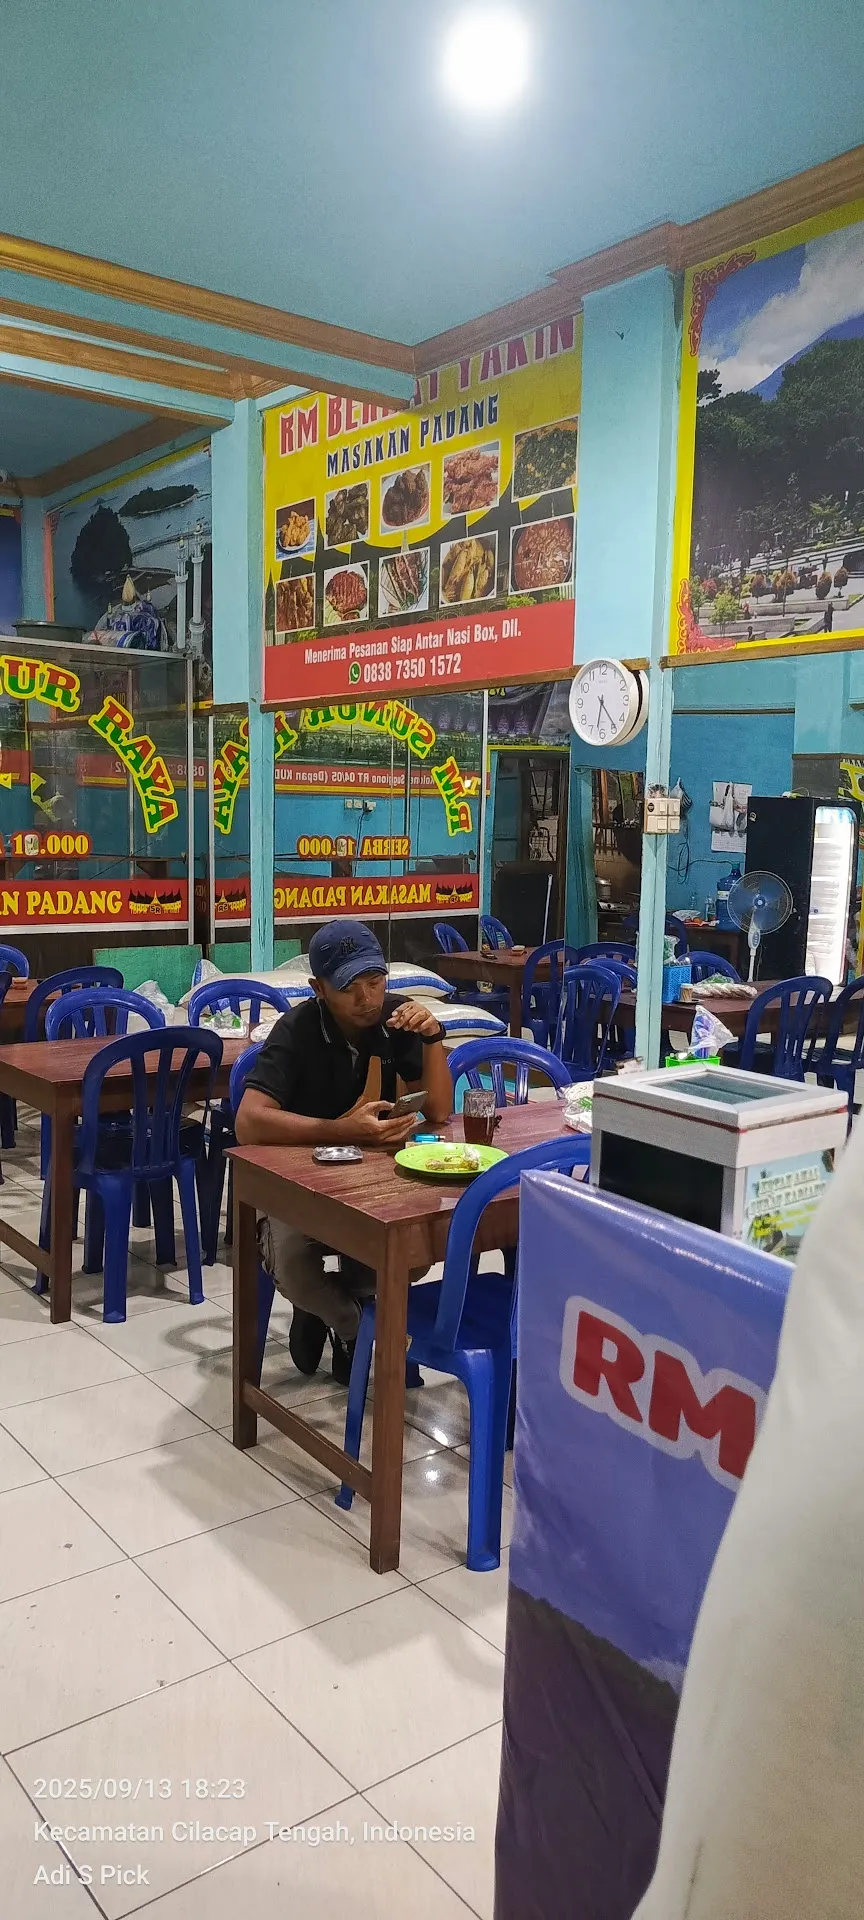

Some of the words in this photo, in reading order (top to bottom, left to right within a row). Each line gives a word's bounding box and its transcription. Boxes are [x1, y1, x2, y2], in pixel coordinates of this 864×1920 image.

[280, 401, 319, 456] RM
[326, 425, 410, 479] MASAKAN
[420, 393, 498, 447] PADANG
[304, 645, 347, 664] Menerima
[349, 641, 388, 659] Pesanan
[390, 635, 413, 655] Siap
[415, 632, 444, 650] Antar
[446, 625, 471, 646] Nasi
[473, 623, 498, 643] Box,
[501, 617, 522, 639] Dll.
[363, 661, 392, 683] 0838
[396, 656, 426, 679] 7350
[430, 652, 462, 676] 1572
[599, 663, 608, 676] 12
[580, 682, 590, 694] 10
[622, 694, 630, 706] 3
[576, 697, 584, 709] 9
[618, 711, 626, 724] 4
[599, 728, 606, 740] 6
[90, 697, 178, 833] RAYA
[12, 834, 89, 857] 1.000
[26, 890, 123, 915] PADANG
[573, 1310, 758, 1480] RM
